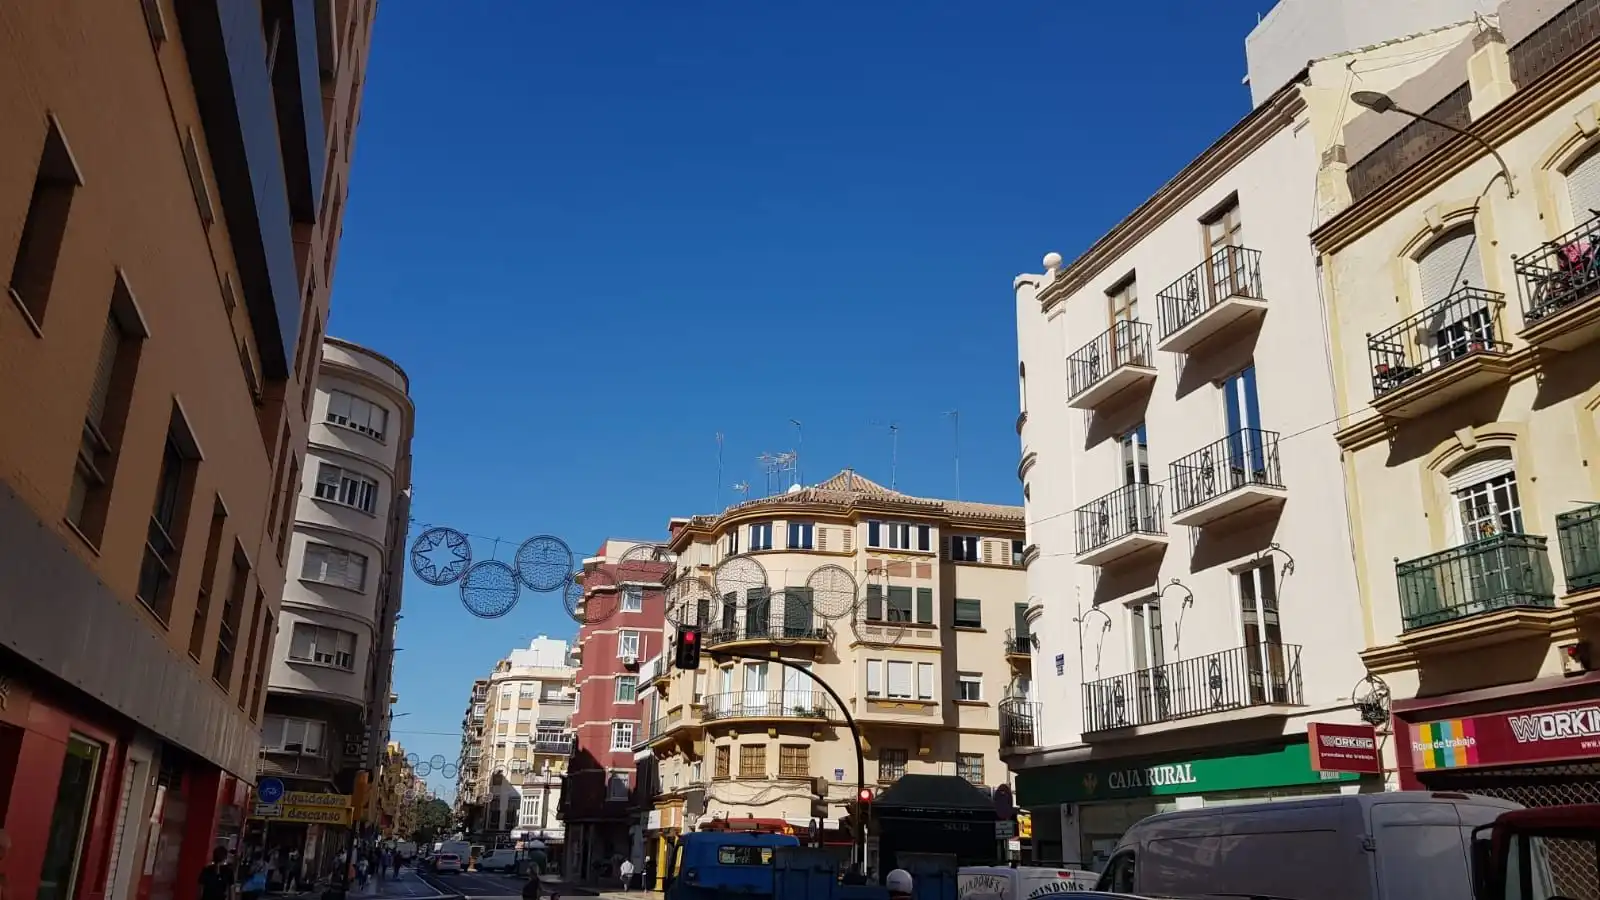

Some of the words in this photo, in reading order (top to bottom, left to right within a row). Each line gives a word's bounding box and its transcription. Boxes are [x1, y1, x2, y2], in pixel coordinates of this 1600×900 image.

[1320, 735, 1375, 749] WORKING
[1434, 739, 1445, 748] de
[1445, 736, 1476, 748] trabajo
[1108, 769, 1142, 789] CAJA
[1144, 763, 1197, 786] RURAL
